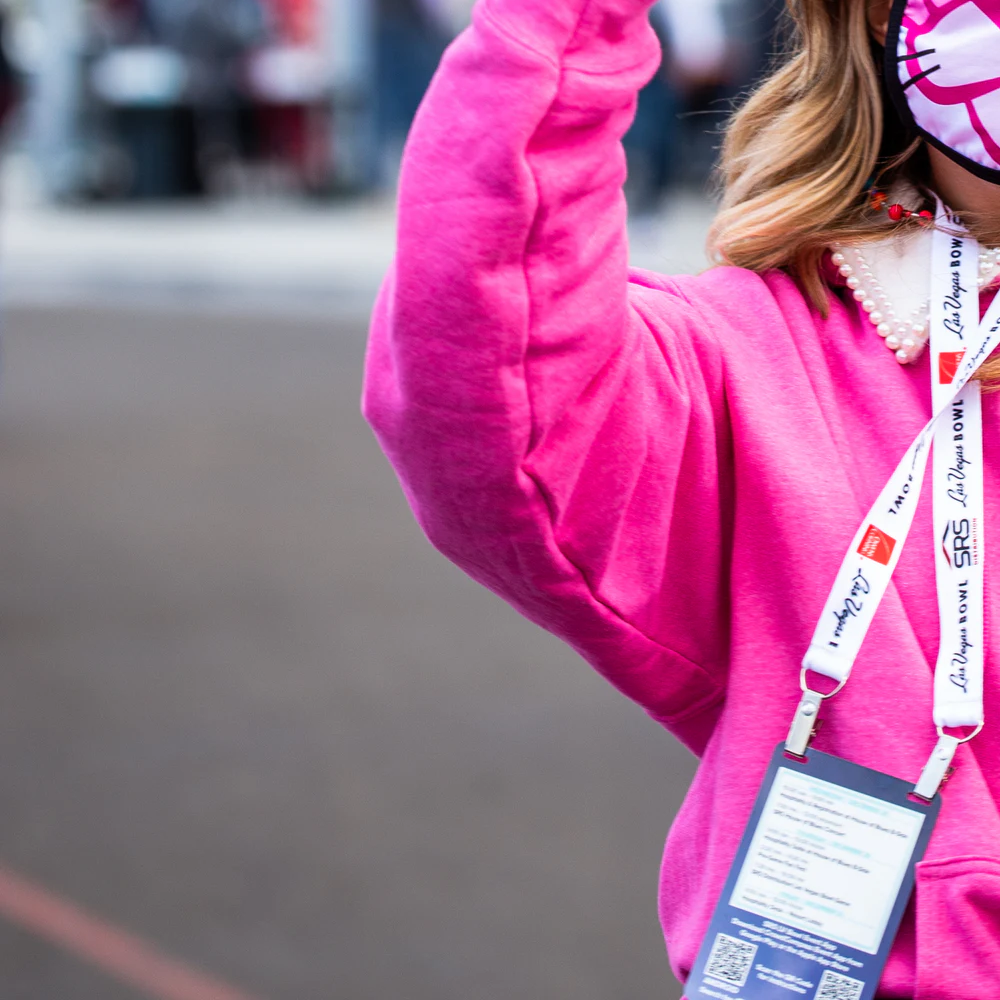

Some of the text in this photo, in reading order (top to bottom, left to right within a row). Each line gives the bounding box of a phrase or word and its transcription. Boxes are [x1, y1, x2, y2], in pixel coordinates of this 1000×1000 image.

[949, 238, 964, 268] BOW
[943, 270, 968, 311] Vegas
[943, 312, 964, 341] Las
[951, 398, 965, 442] BOWL
[947, 444, 972, 482] Vegas
[947, 483, 967, 508] Las
[952, 517, 972, 569] SRS
[850, 567, 870, 596] Las
[832, 598, 863, 638] Vegas
[949, 579, 973, 694] Las Vegas BOWL
